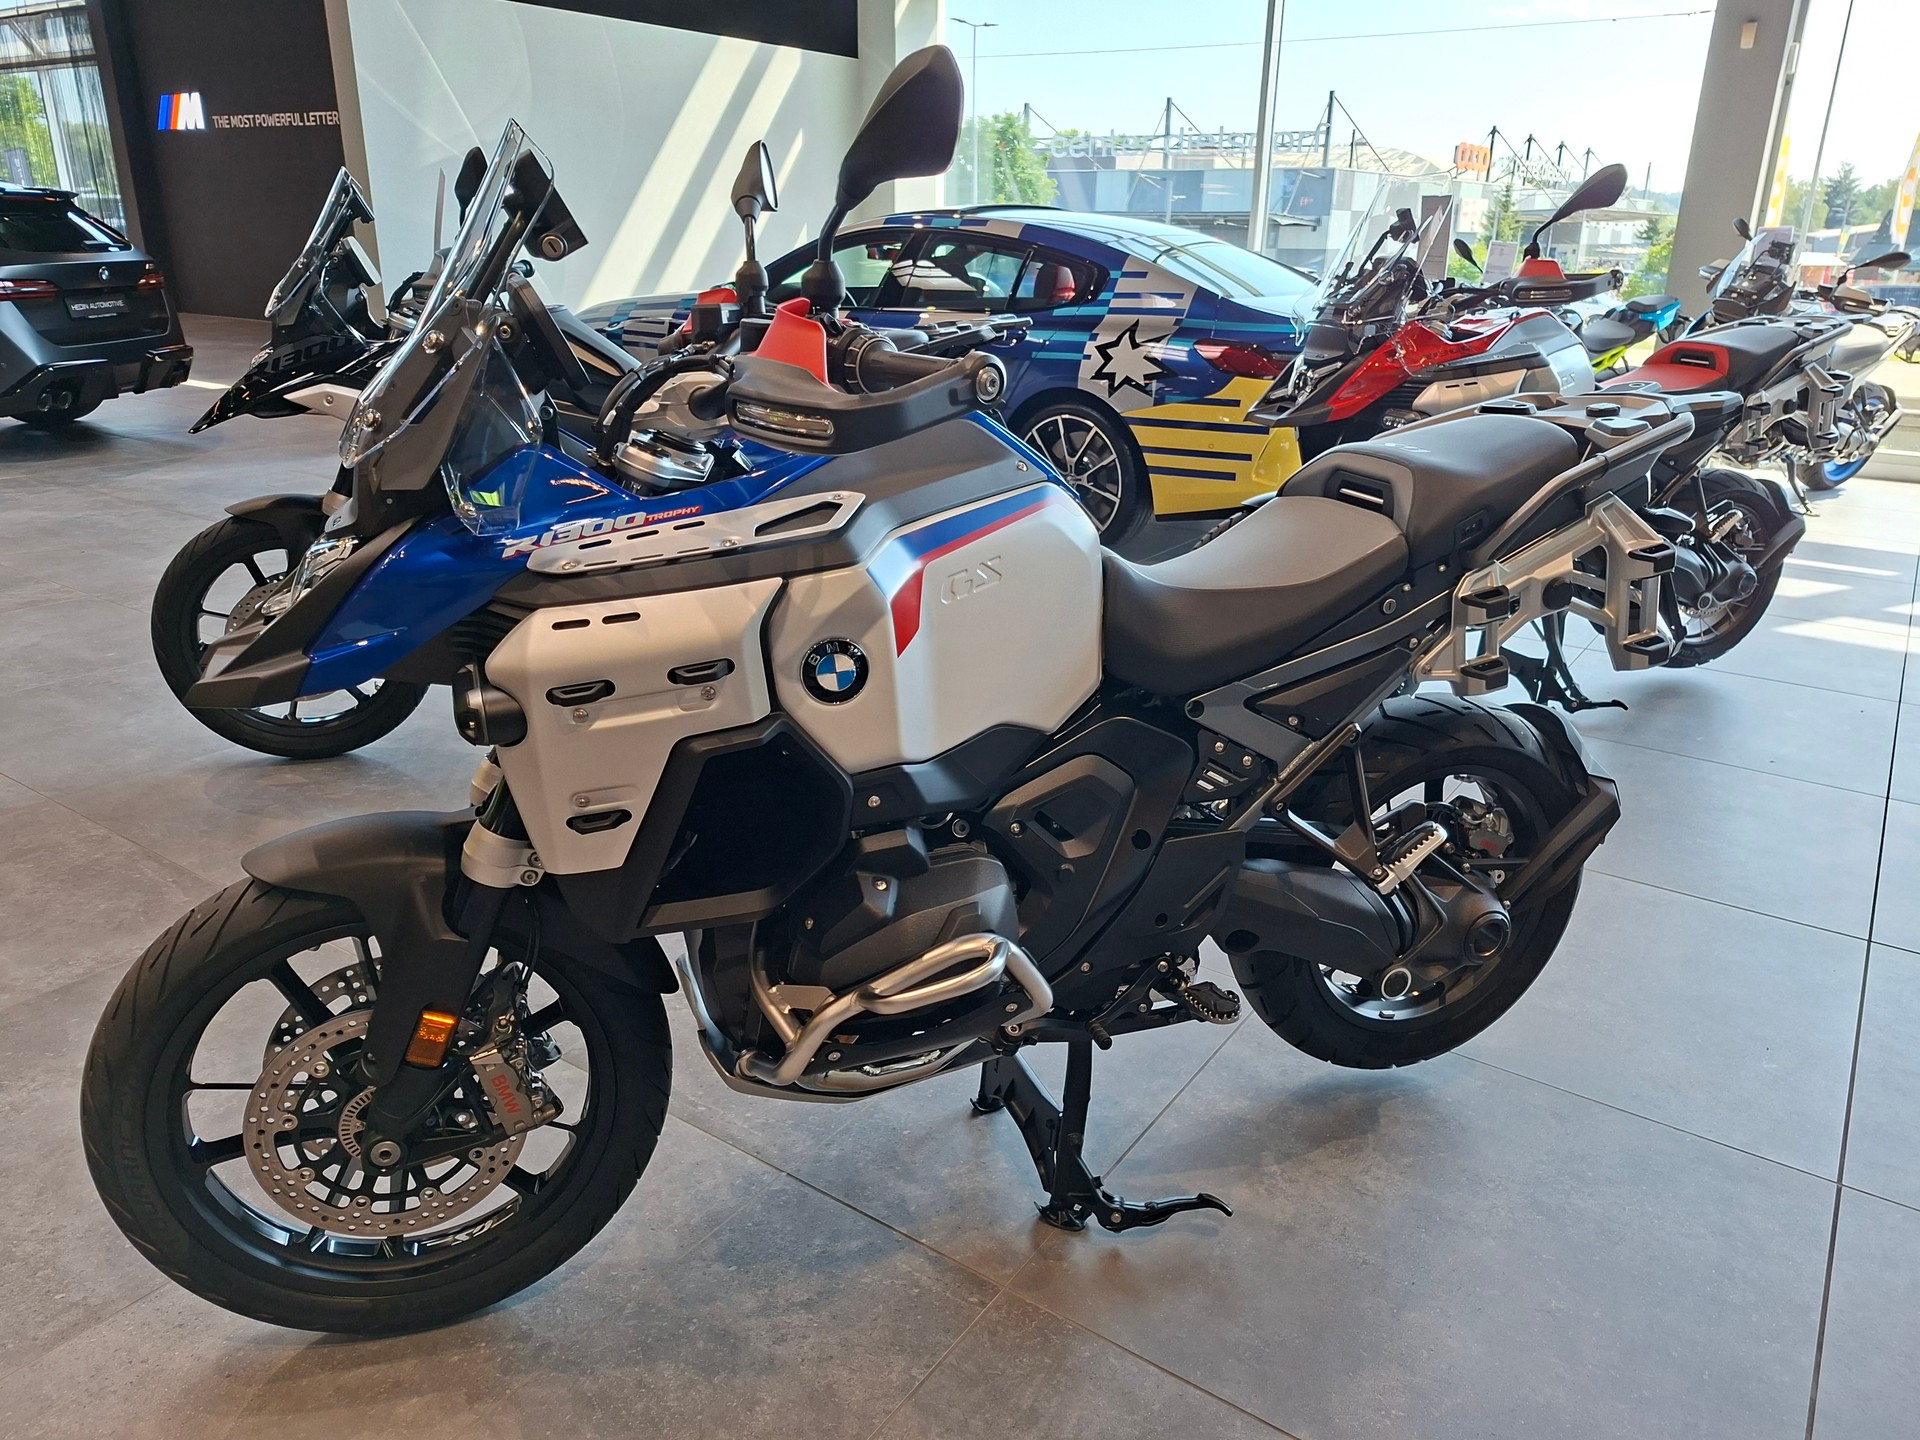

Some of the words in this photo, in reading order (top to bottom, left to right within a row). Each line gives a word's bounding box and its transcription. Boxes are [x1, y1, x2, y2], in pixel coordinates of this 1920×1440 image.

[212, 115, 231, 128] THE
[231, 114, 254, 128] MOST
[255, 112, 302, 127] POWERFUL
[303, 110, 340, 126] LETTER
[647, 505, 700, 521] TROPHY
[491, 1074, 525, 1114] BMW
